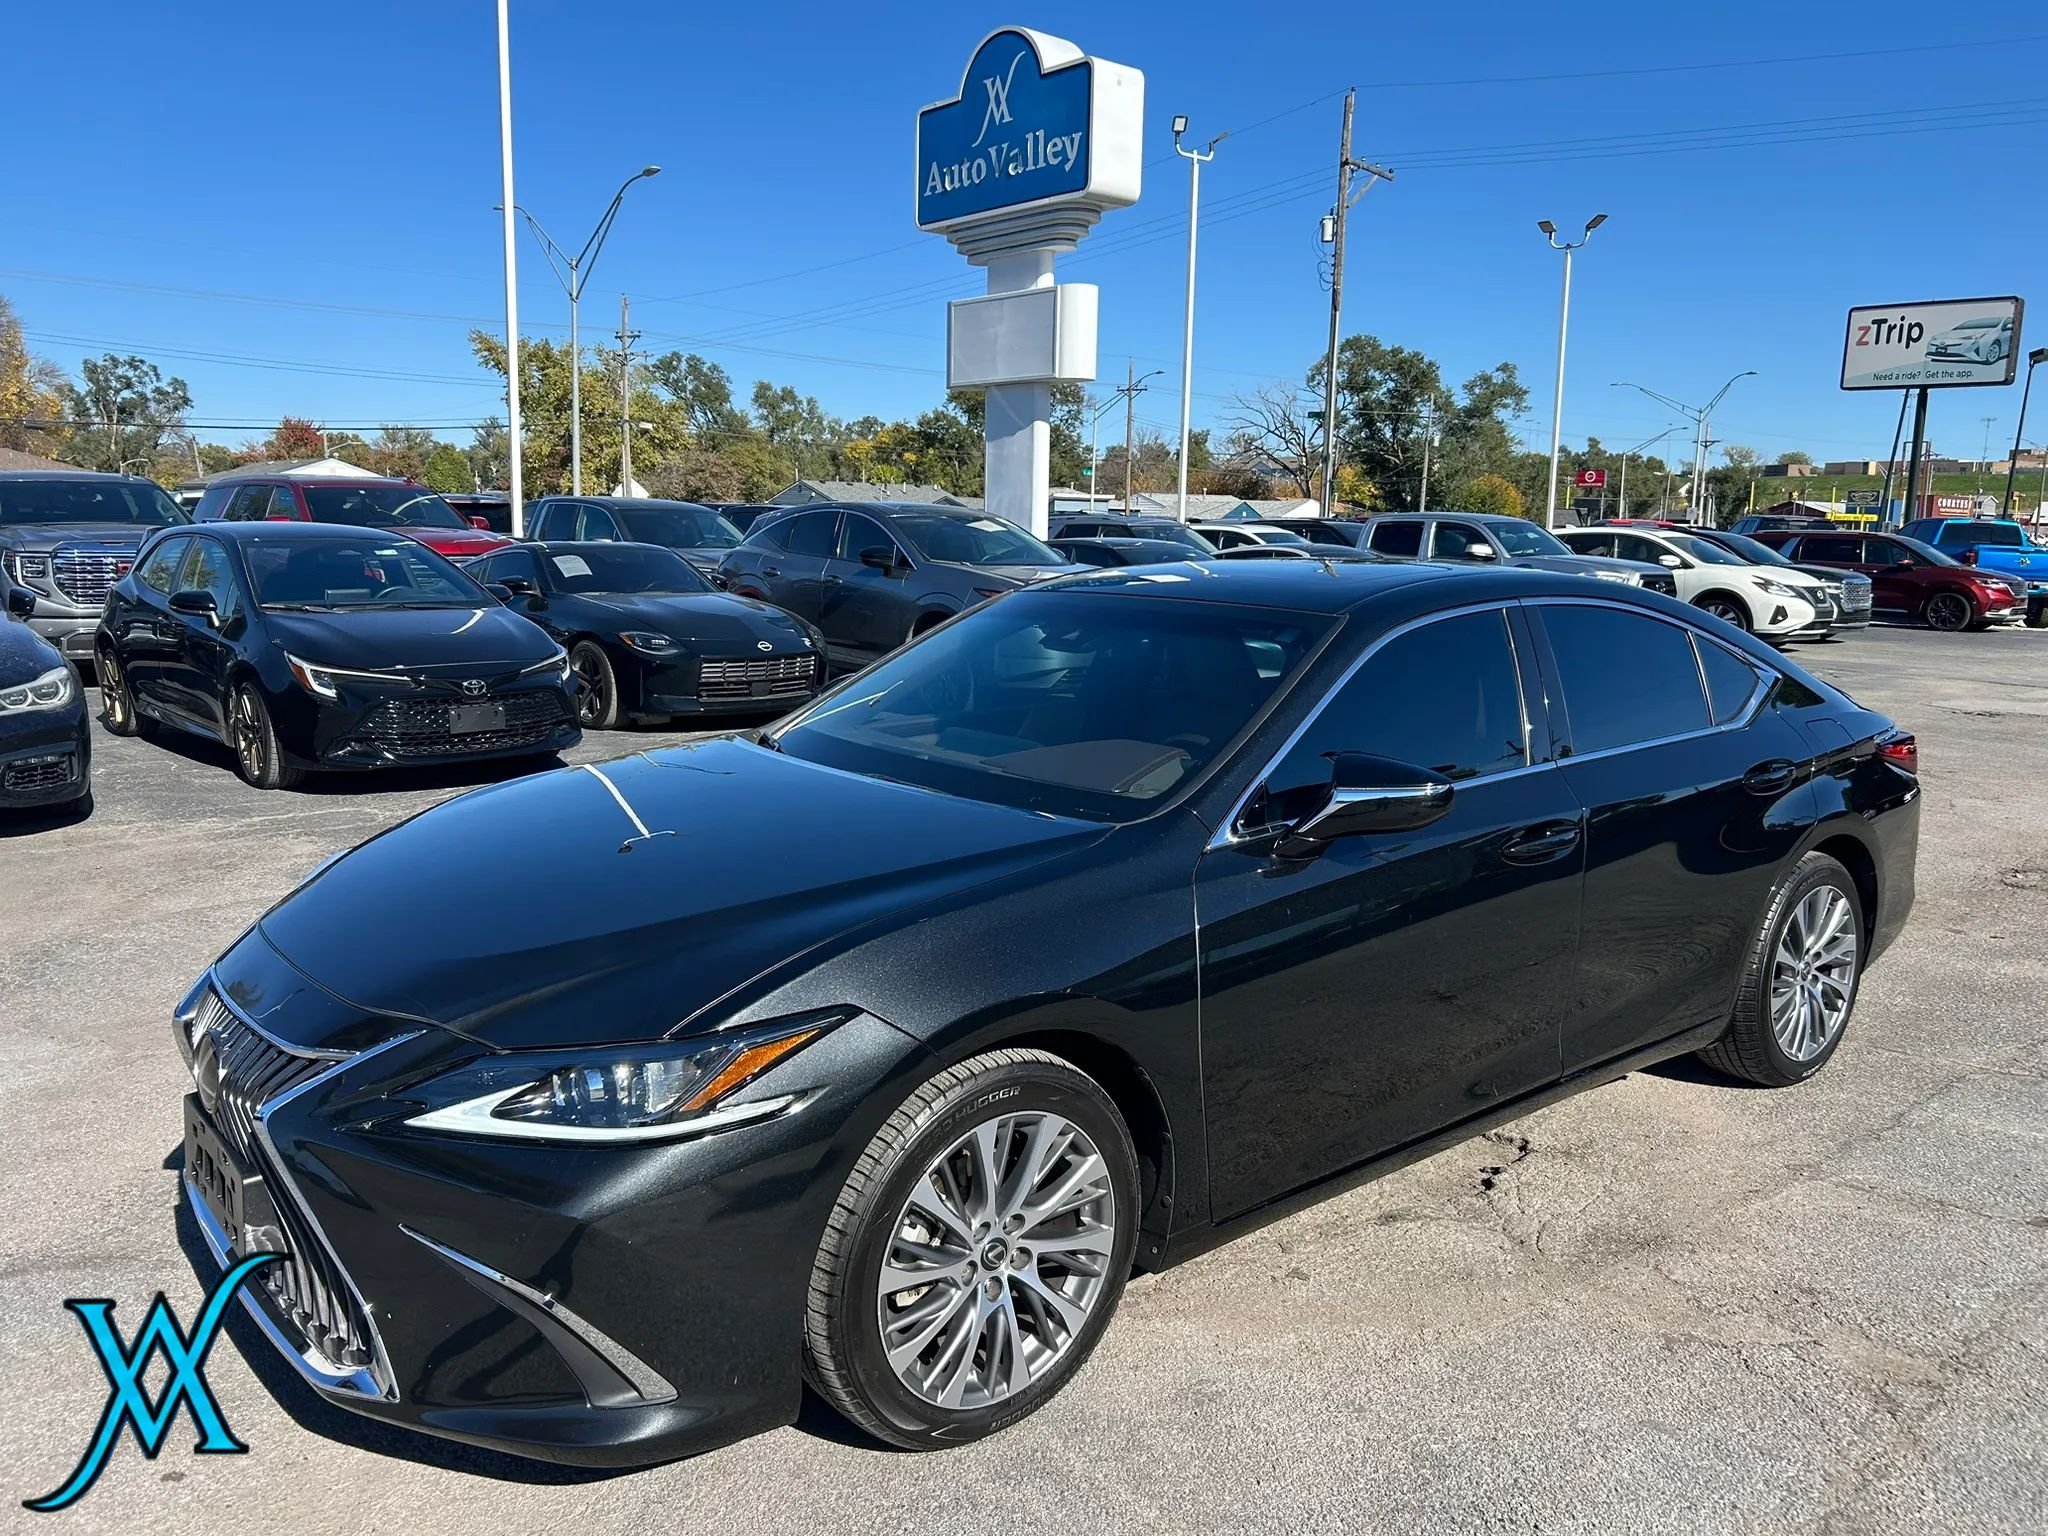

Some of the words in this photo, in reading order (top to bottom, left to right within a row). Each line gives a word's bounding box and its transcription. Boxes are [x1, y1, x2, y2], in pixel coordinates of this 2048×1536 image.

[1855, 315, 1924, 349] zTrip
[1872, 372, 1893, 381] Need
[1901, 371, 1921, 380] ride?
[1925, 370, 1939, 379] Get
[1941, 369, 1954, 378] the
[1956, 370, 1974, 379] app.
